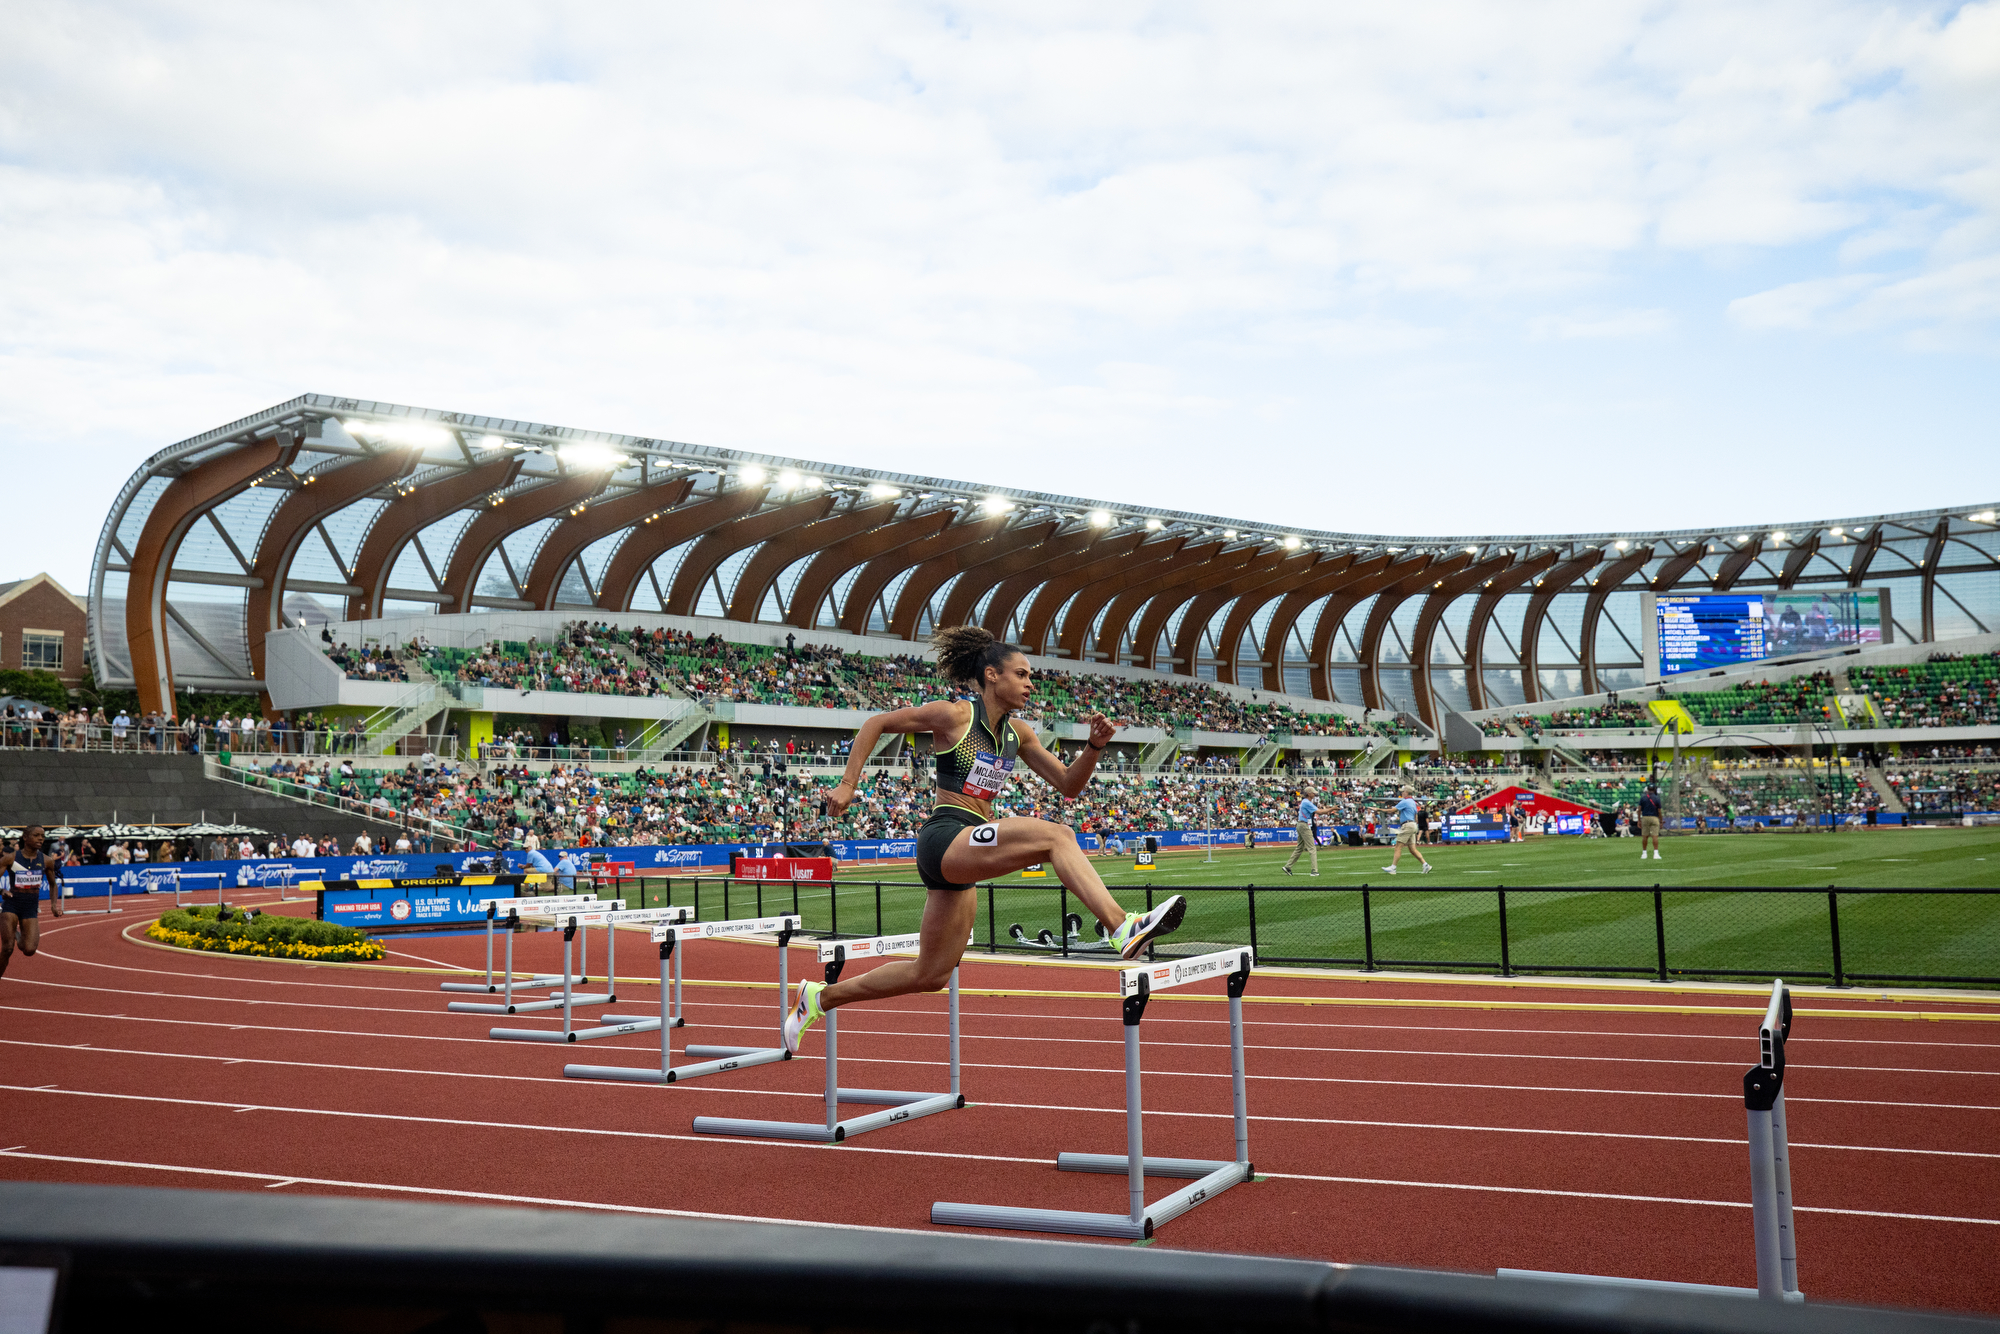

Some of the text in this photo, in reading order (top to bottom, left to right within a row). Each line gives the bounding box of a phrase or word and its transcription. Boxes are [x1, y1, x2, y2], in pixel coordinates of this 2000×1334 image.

[668, 849, 698, 864] Sports
[1138, 853, 1152, 863] 60
[369, 860, 408, 876] Sports
[797, 869, 814, 879] USATF
[401, 878, 453, 886] OREGON
[892, 941, 905, 949] OLYMPIC
[1127, 980, 1137, 988] UCS
[1188, 965, 1199, 976] OLYMPIC
[1207, 961, 1217, 971] TRIALS
[1224, 960, 1233, 968] USATF
[719, 1061, 738, 1070] UCS
[889, 1110, 909, 1122] UCS
[1188, 1188, 1206, 1205] UCS
